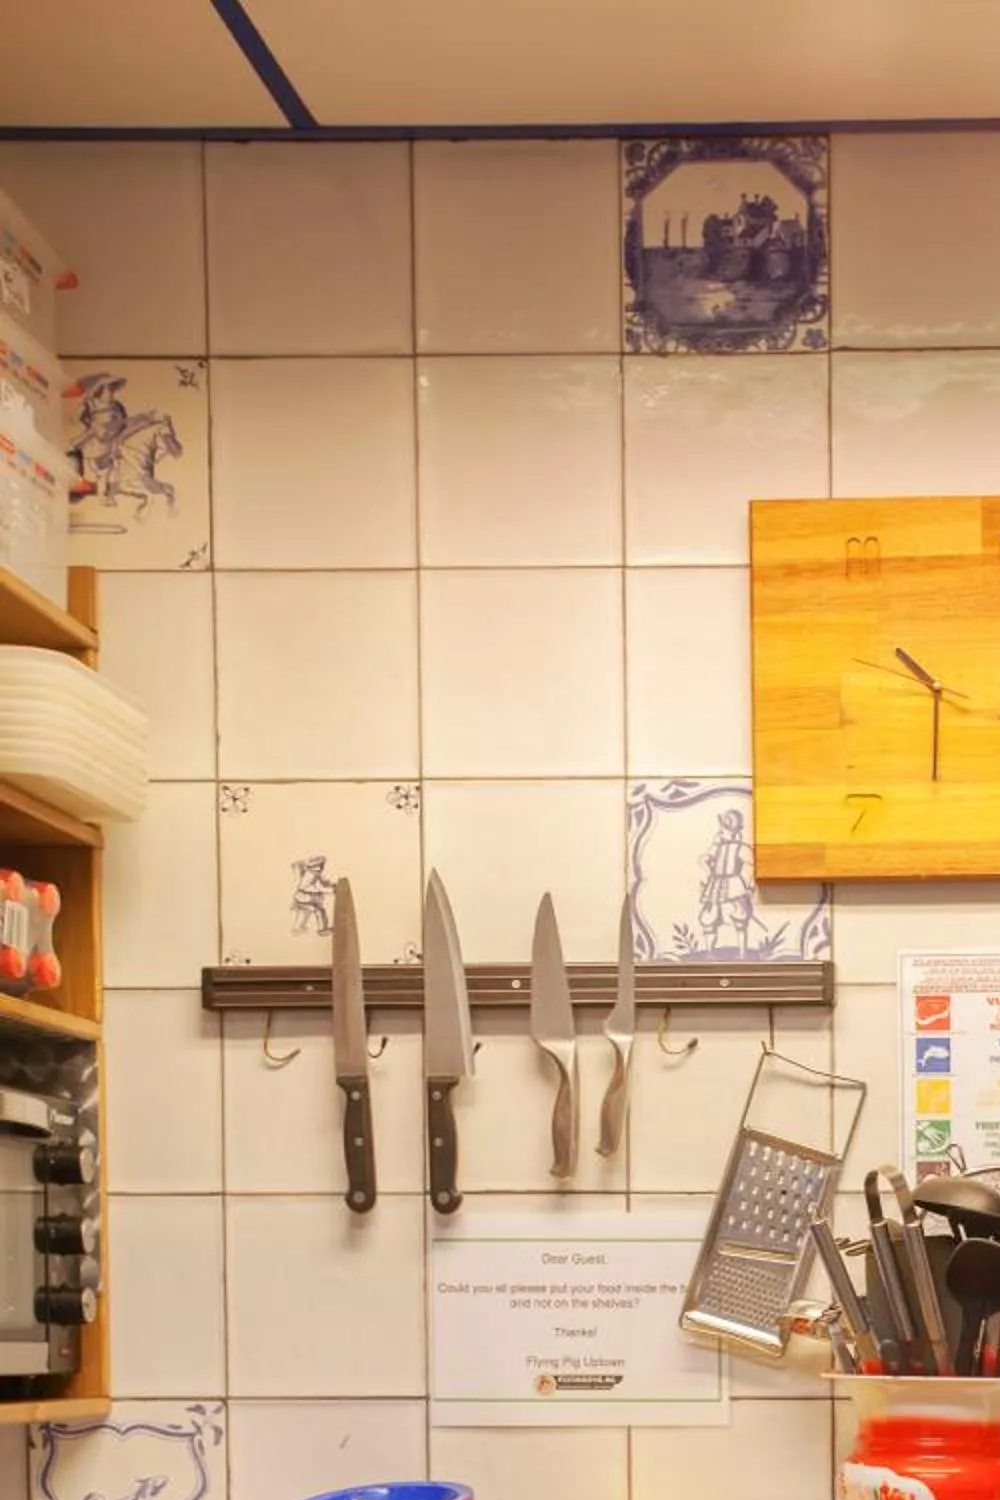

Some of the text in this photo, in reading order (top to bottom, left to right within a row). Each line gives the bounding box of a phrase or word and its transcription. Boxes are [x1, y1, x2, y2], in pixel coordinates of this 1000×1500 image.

[541, 1252, 569, 1265] Dear
[438, 1282, 470, 1294] Could
[472, 1284, 494, 1297] you
[510, 1283, 547, 1297] please
[549, 1284, 568, 1297] put
[570, 1284, 595, 1297] your
[597, 1283, 622, 1294] food
[625, 1283, 657, 1294] inside
[659, 1283, 678, 1294] the
[510, 1297, 641, 1310] and not on the shelves?
[554, 1326, 598, 1338] Thanks!
[525, 1355, 625, 1369] Flying Pig Uptown
